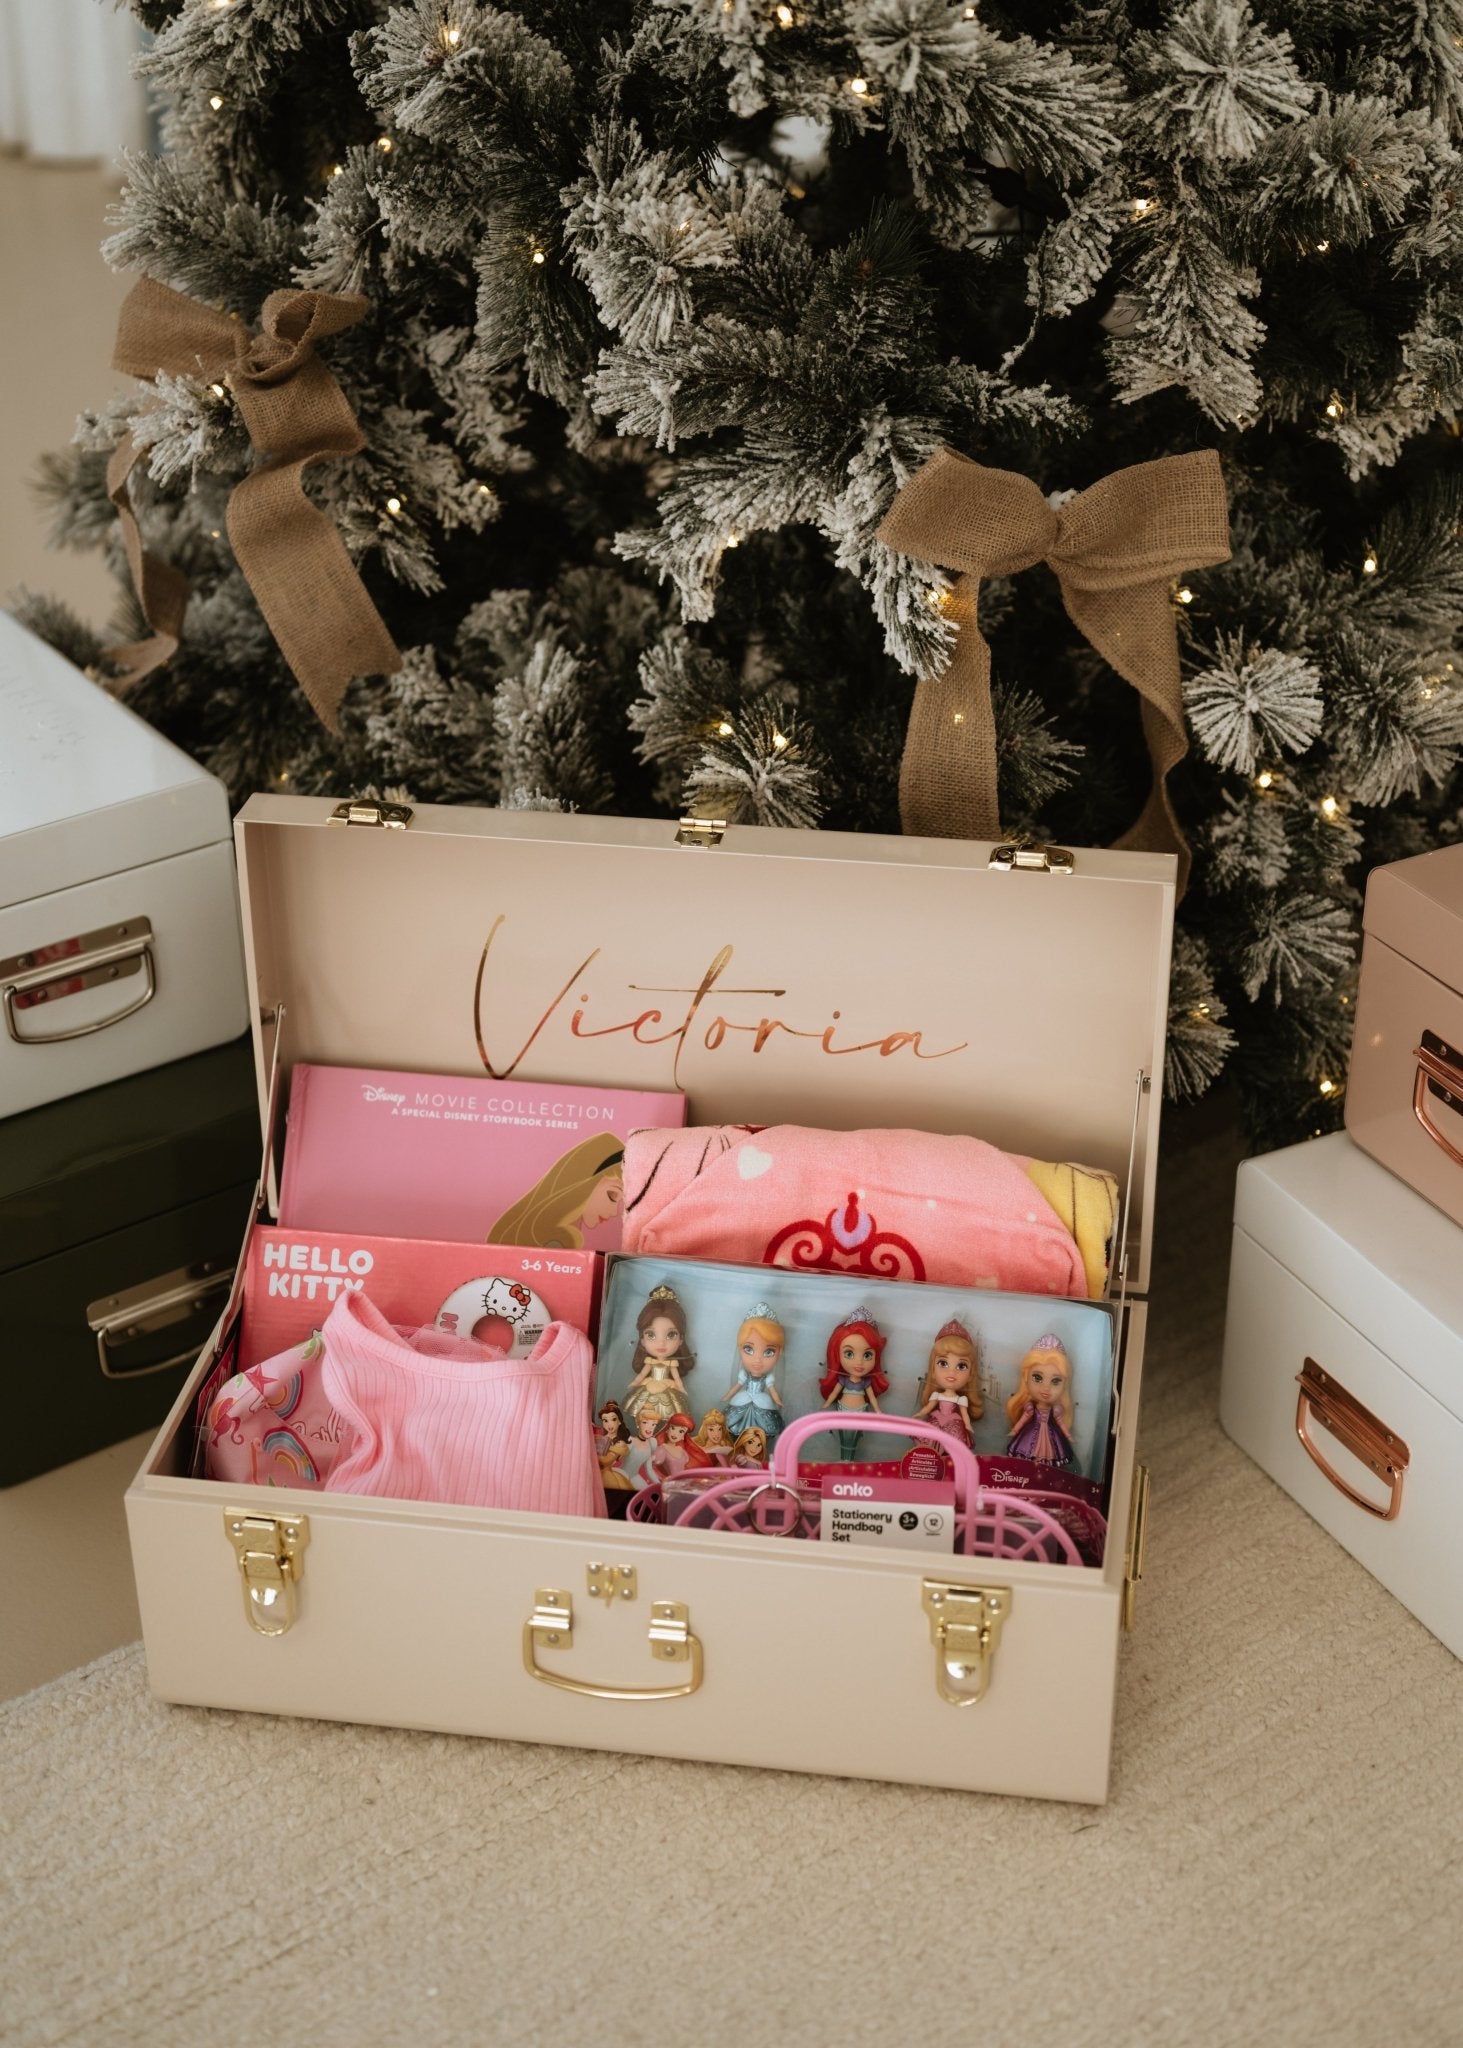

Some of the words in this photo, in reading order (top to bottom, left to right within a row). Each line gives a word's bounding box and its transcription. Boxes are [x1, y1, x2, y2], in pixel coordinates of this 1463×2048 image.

[473, 914, 968, 1091] Victoria
[361, 1084, 406, 1107] Disney
[415, 1092, 477, 1111] MOVIE
[487, 1098, 614, 1121] COLLECTION
[391, 1107, 399, 1116] A
[401, 1108, 441, 1119] SPECIAL
[444, 1111, 480, 1122] DISNEY
[483, 1114, 542, 1127] STORYBOOK
[545, 1119, 578, 1130] SERIES
[263, 1242, 374, 1275] HELLO
[521, 1259, 541, 1271] 3-6
[545, 1261, 582, 1274] Years
[832, 1482, 873, 1497] anko
[832, 1508, 893, 1524] Stationery
[902, 1513, 915, 1524] 3+
[832, 1520, 883, 1534] Handbag
[831, 1532, 851, 1542] Set
